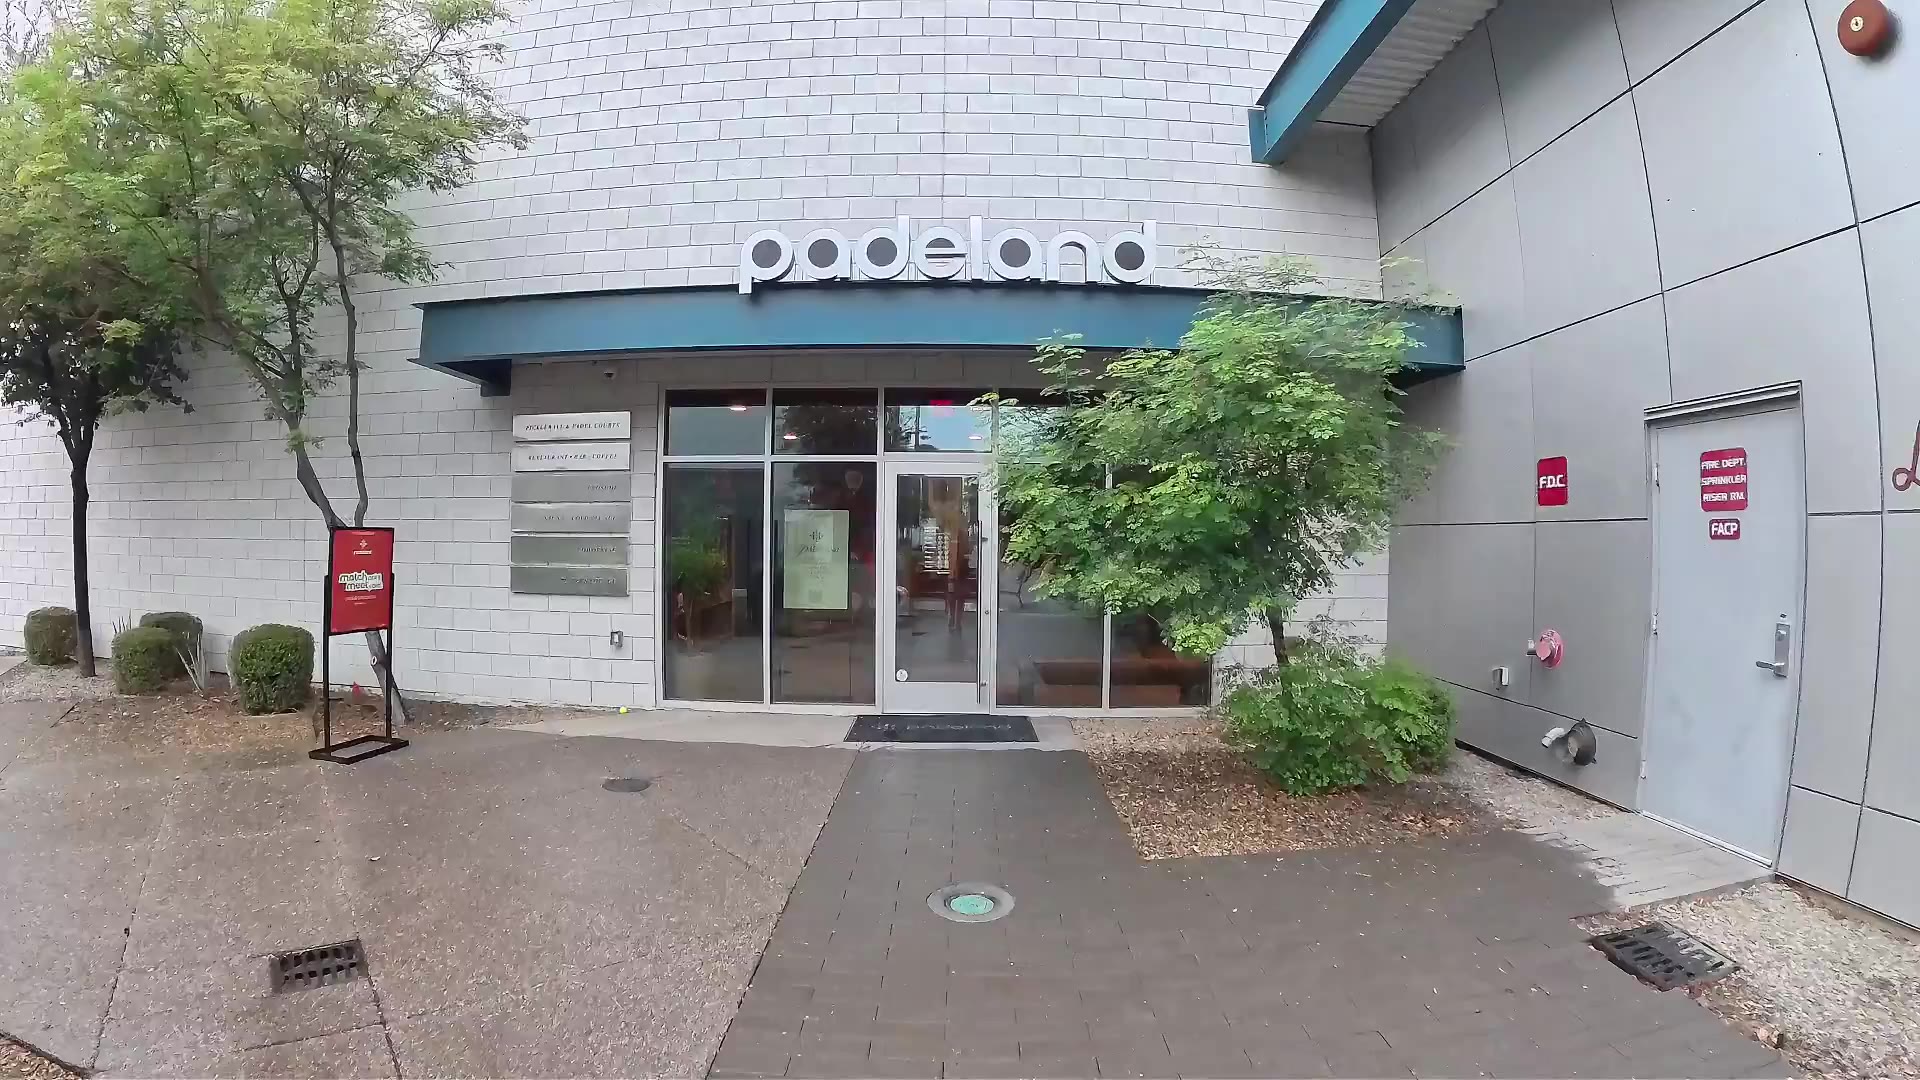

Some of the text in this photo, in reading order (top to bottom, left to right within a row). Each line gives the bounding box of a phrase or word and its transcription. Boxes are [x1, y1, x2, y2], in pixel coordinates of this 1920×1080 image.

[739, 215, 1157, 295] padeland
[1701, 458, 1746, 470] FIRE DEPT.
[1701, 474, 1747, 486] SPRINKLER
[1703, 493, 1728, 503] RISER
[1711, 522, 1739, 536] FACP
